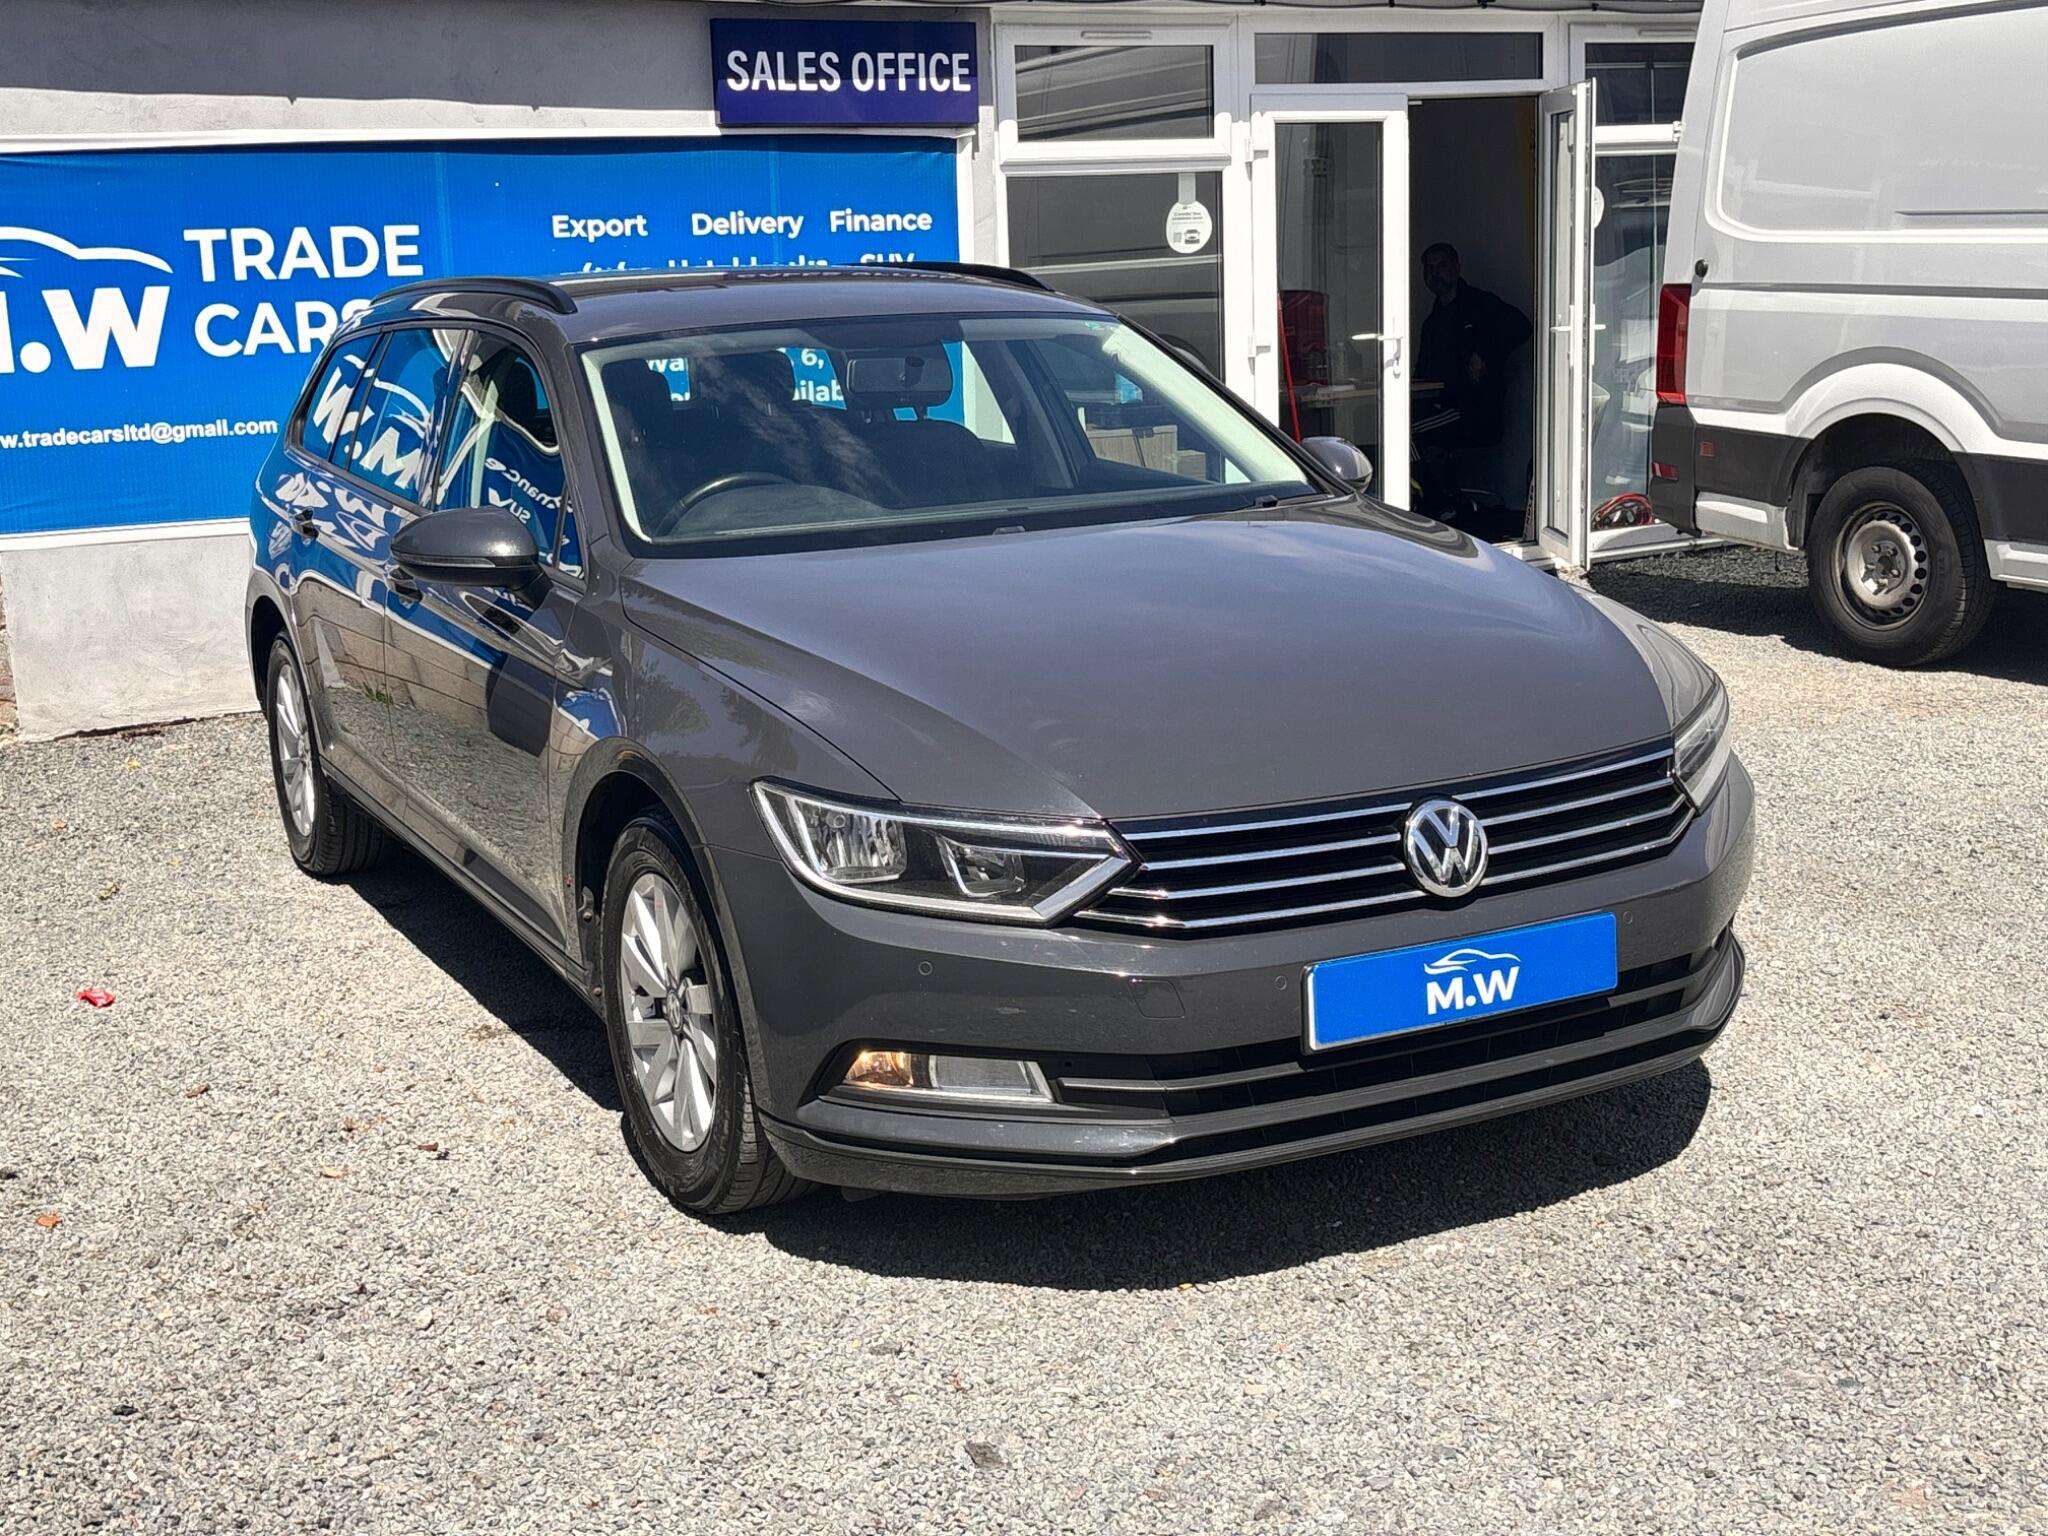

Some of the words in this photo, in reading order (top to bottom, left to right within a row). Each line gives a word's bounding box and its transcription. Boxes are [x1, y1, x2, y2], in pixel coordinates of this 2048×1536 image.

[726, 50, 840, 92] SALES
[852, 52, 972, 92] OFFICE
[552, 215, 648, 243] Export
[692, 210, 804, 239] Delivery
[830, 208, 933, 232] Finance
[183, 224, 424, 282] TRADE
[1425, 965, 1520, 1015] M.W
